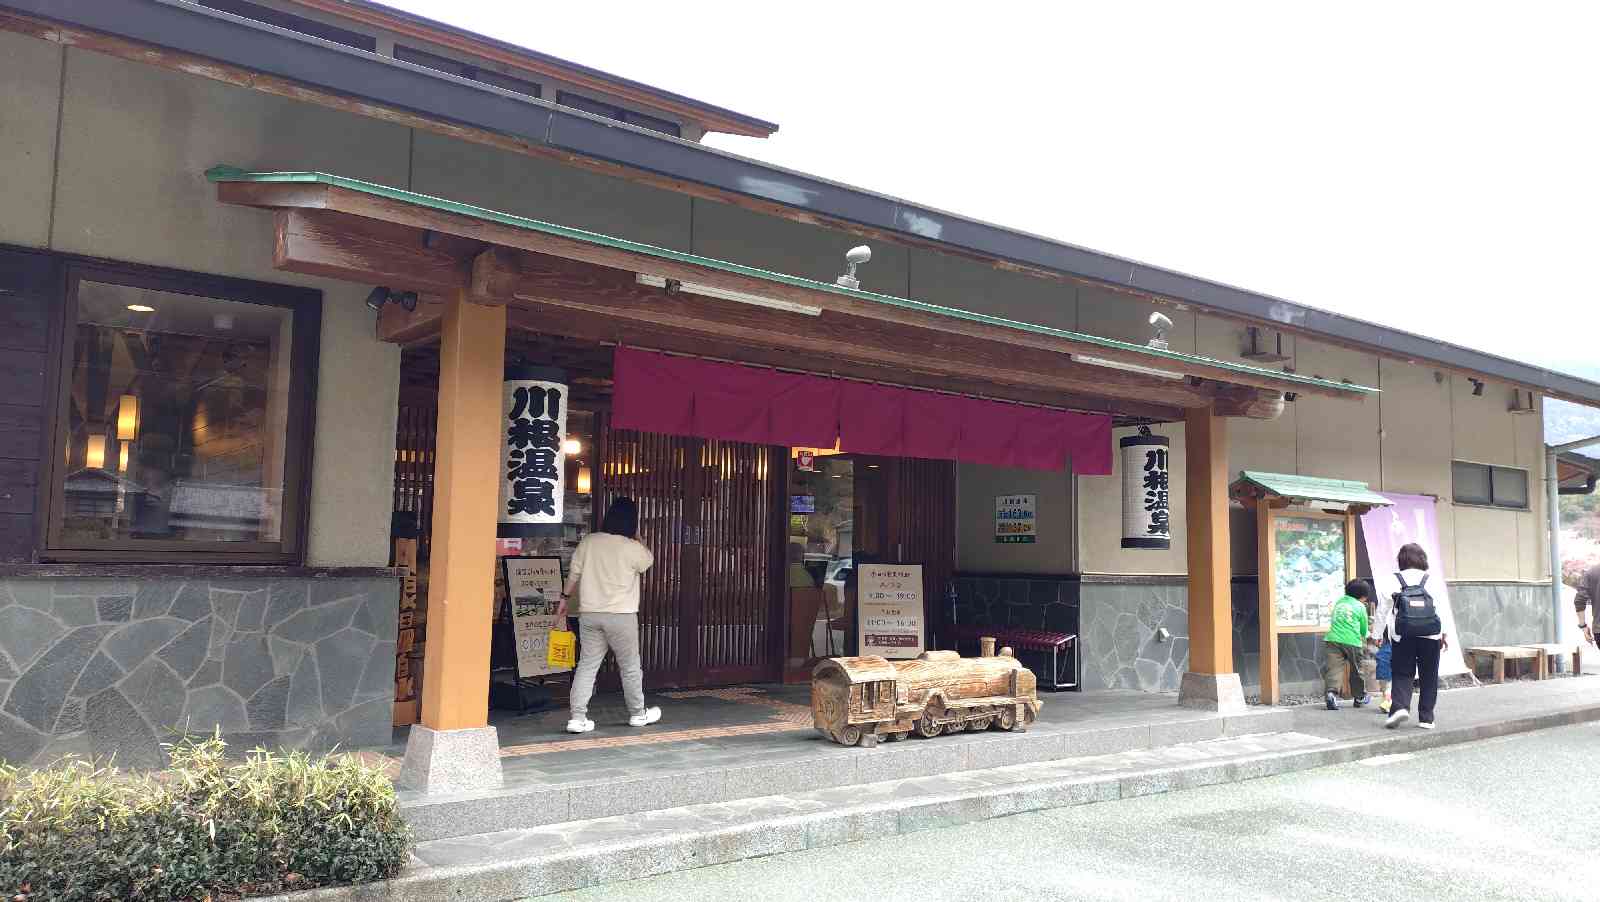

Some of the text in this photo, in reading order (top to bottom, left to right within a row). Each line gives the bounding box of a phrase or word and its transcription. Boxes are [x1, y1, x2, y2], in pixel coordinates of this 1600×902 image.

[508, 386, 561, 516] 川根温泉
[1143, 448, 1168, 534] 川根温泉
